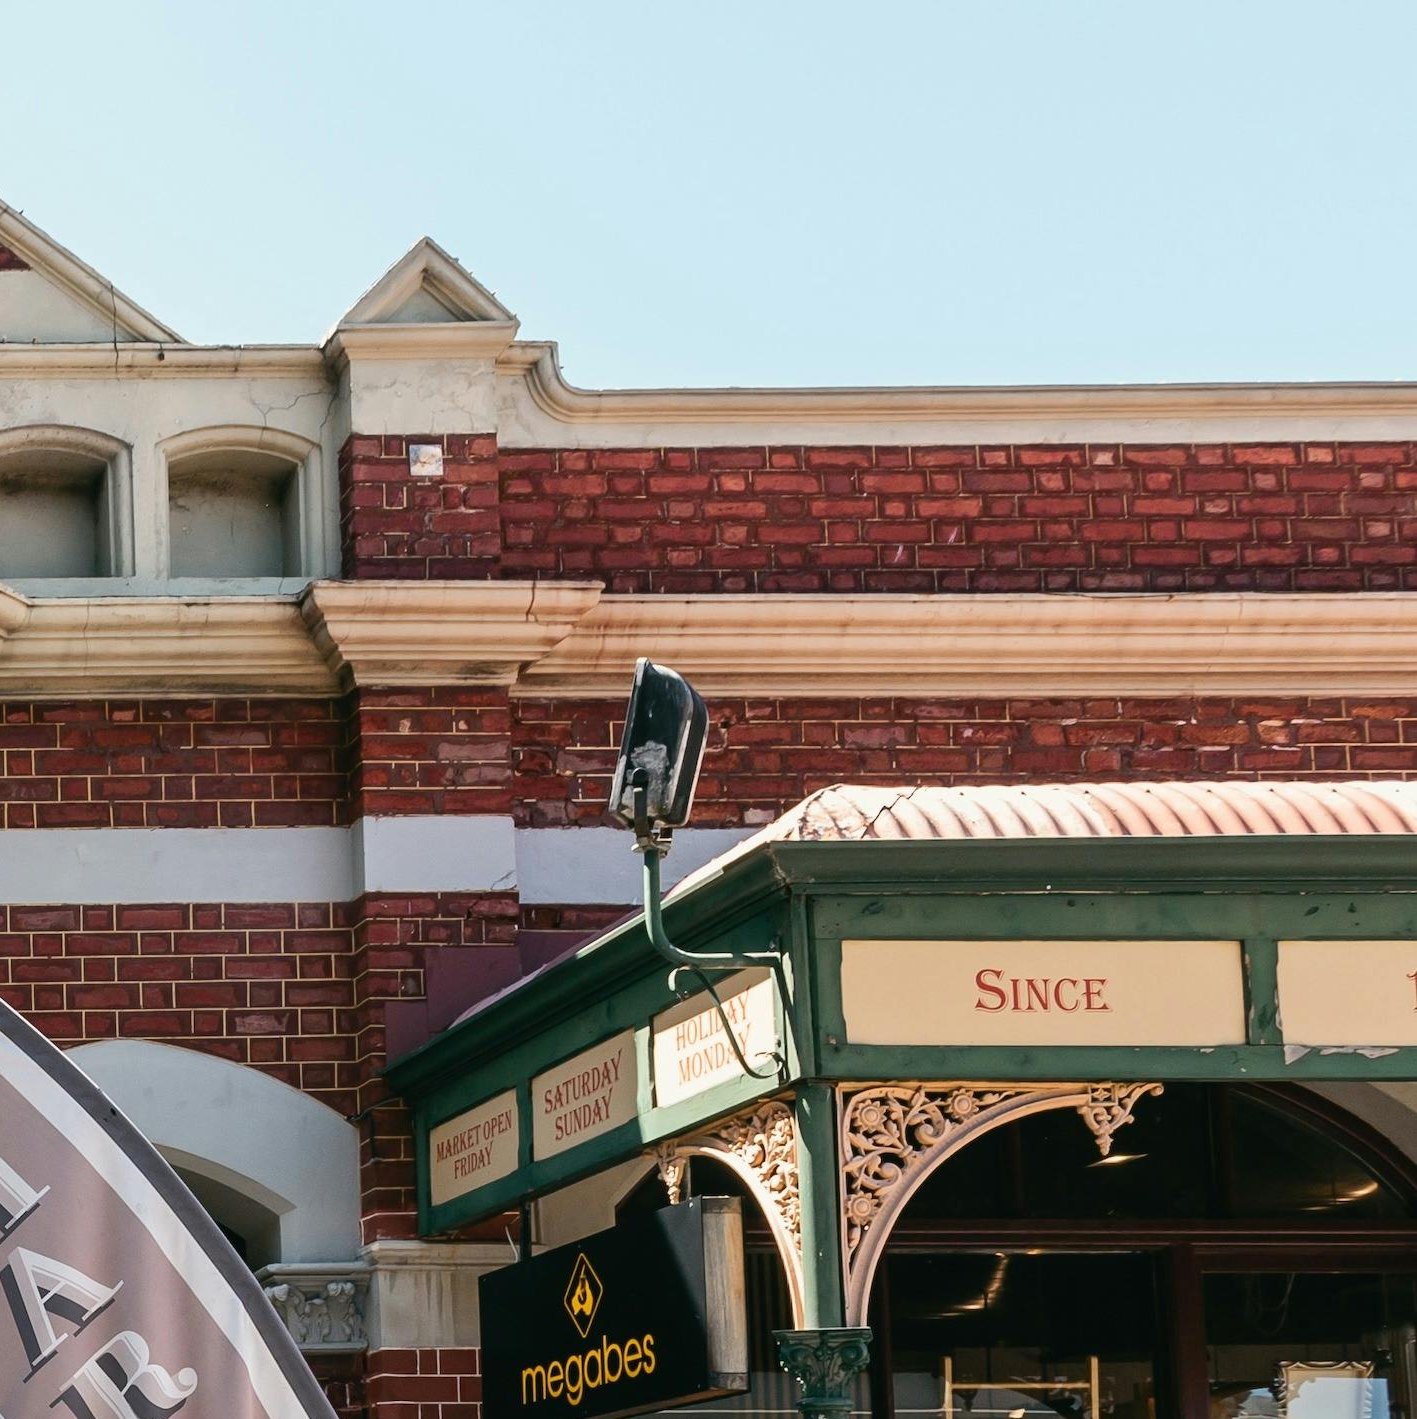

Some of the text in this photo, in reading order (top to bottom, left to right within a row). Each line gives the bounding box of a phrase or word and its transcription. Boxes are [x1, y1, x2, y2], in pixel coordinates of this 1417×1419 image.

[675, 986, 753, 1051] HOLIDAY
[974, 967, 1112, 1012] SINCE
[544, 1048, 624, 1115] SATURDAY
[678, 1023, 752, 1086] MONDAY
[436, 1109, 513, 1165] MARKET OPEN
[555, 1089, 613, 1141] SUNDAY
[453, 1140, 495, 1181] FRIDAY
[521, 1334, 657, 1407] megabes
